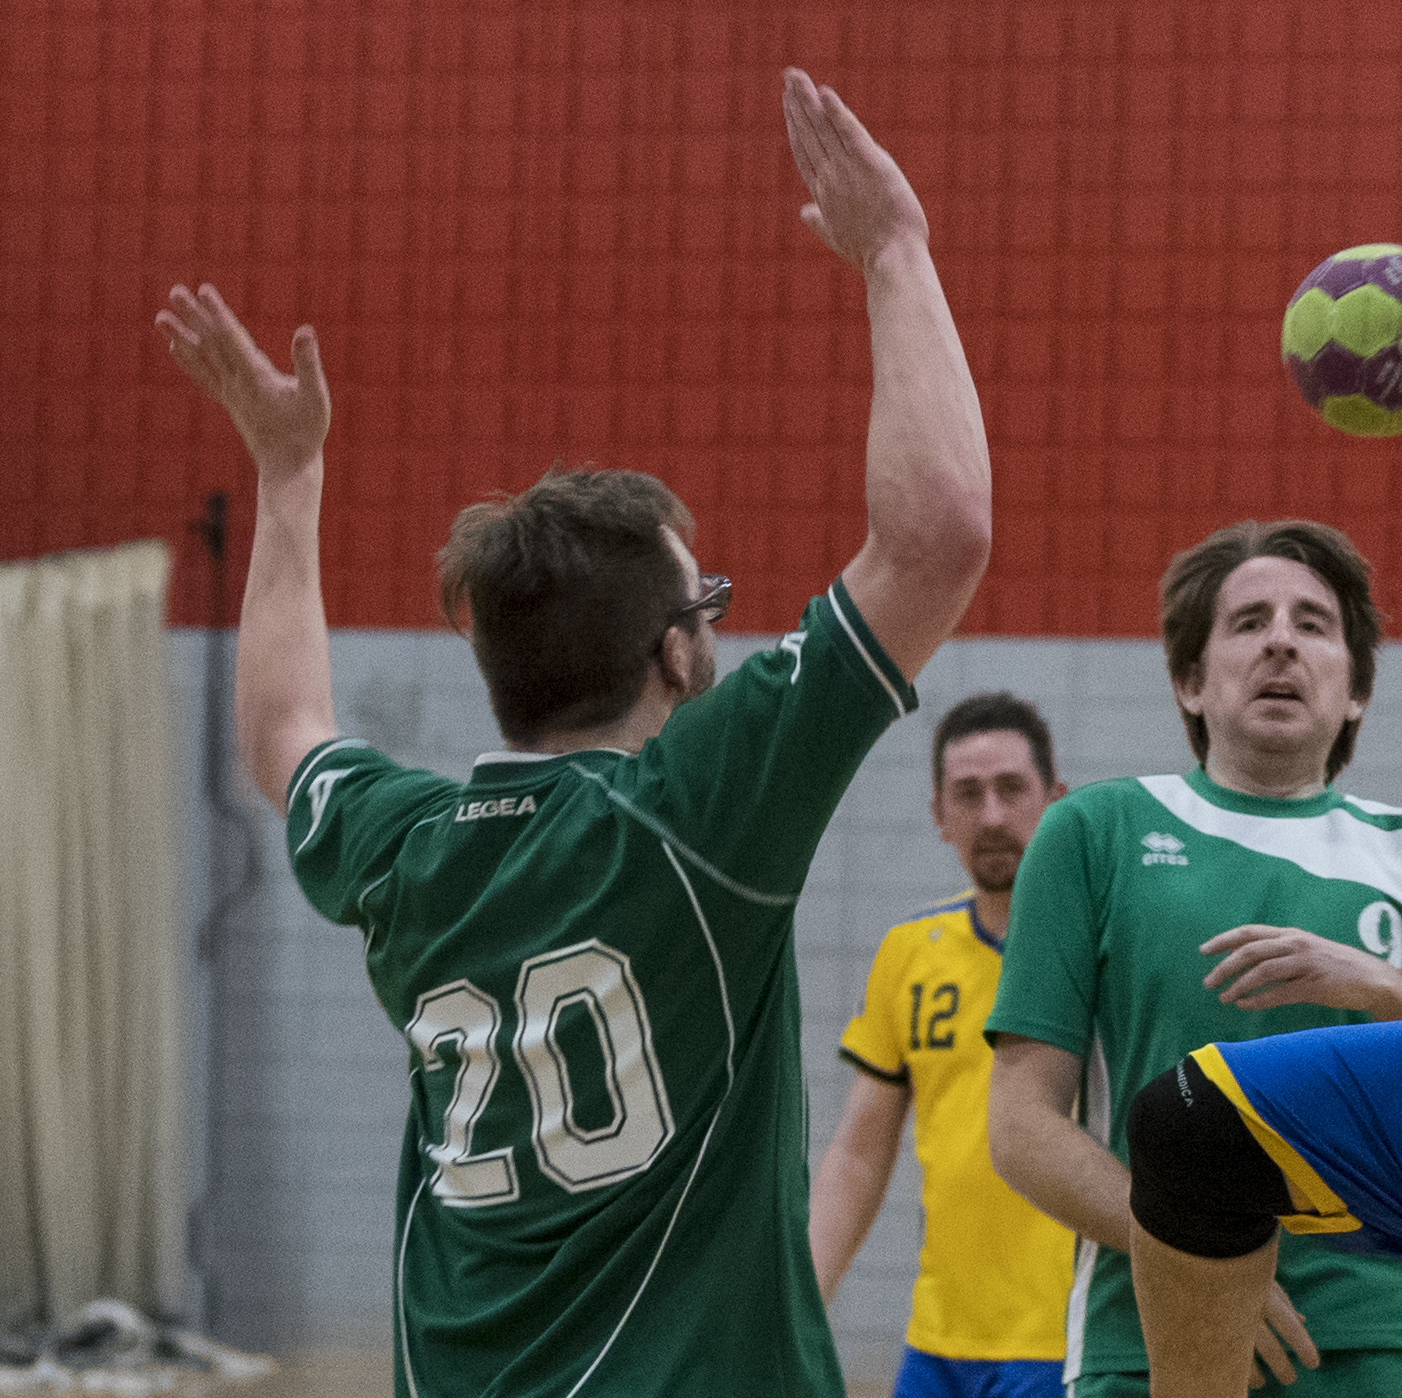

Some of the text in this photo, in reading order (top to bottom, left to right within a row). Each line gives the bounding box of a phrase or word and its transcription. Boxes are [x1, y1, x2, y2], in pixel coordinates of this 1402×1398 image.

[455, 795, 536, 822] LEGEA
[910, 983, 960, 1050] 12
[404, 937, 676, 1208] 20
